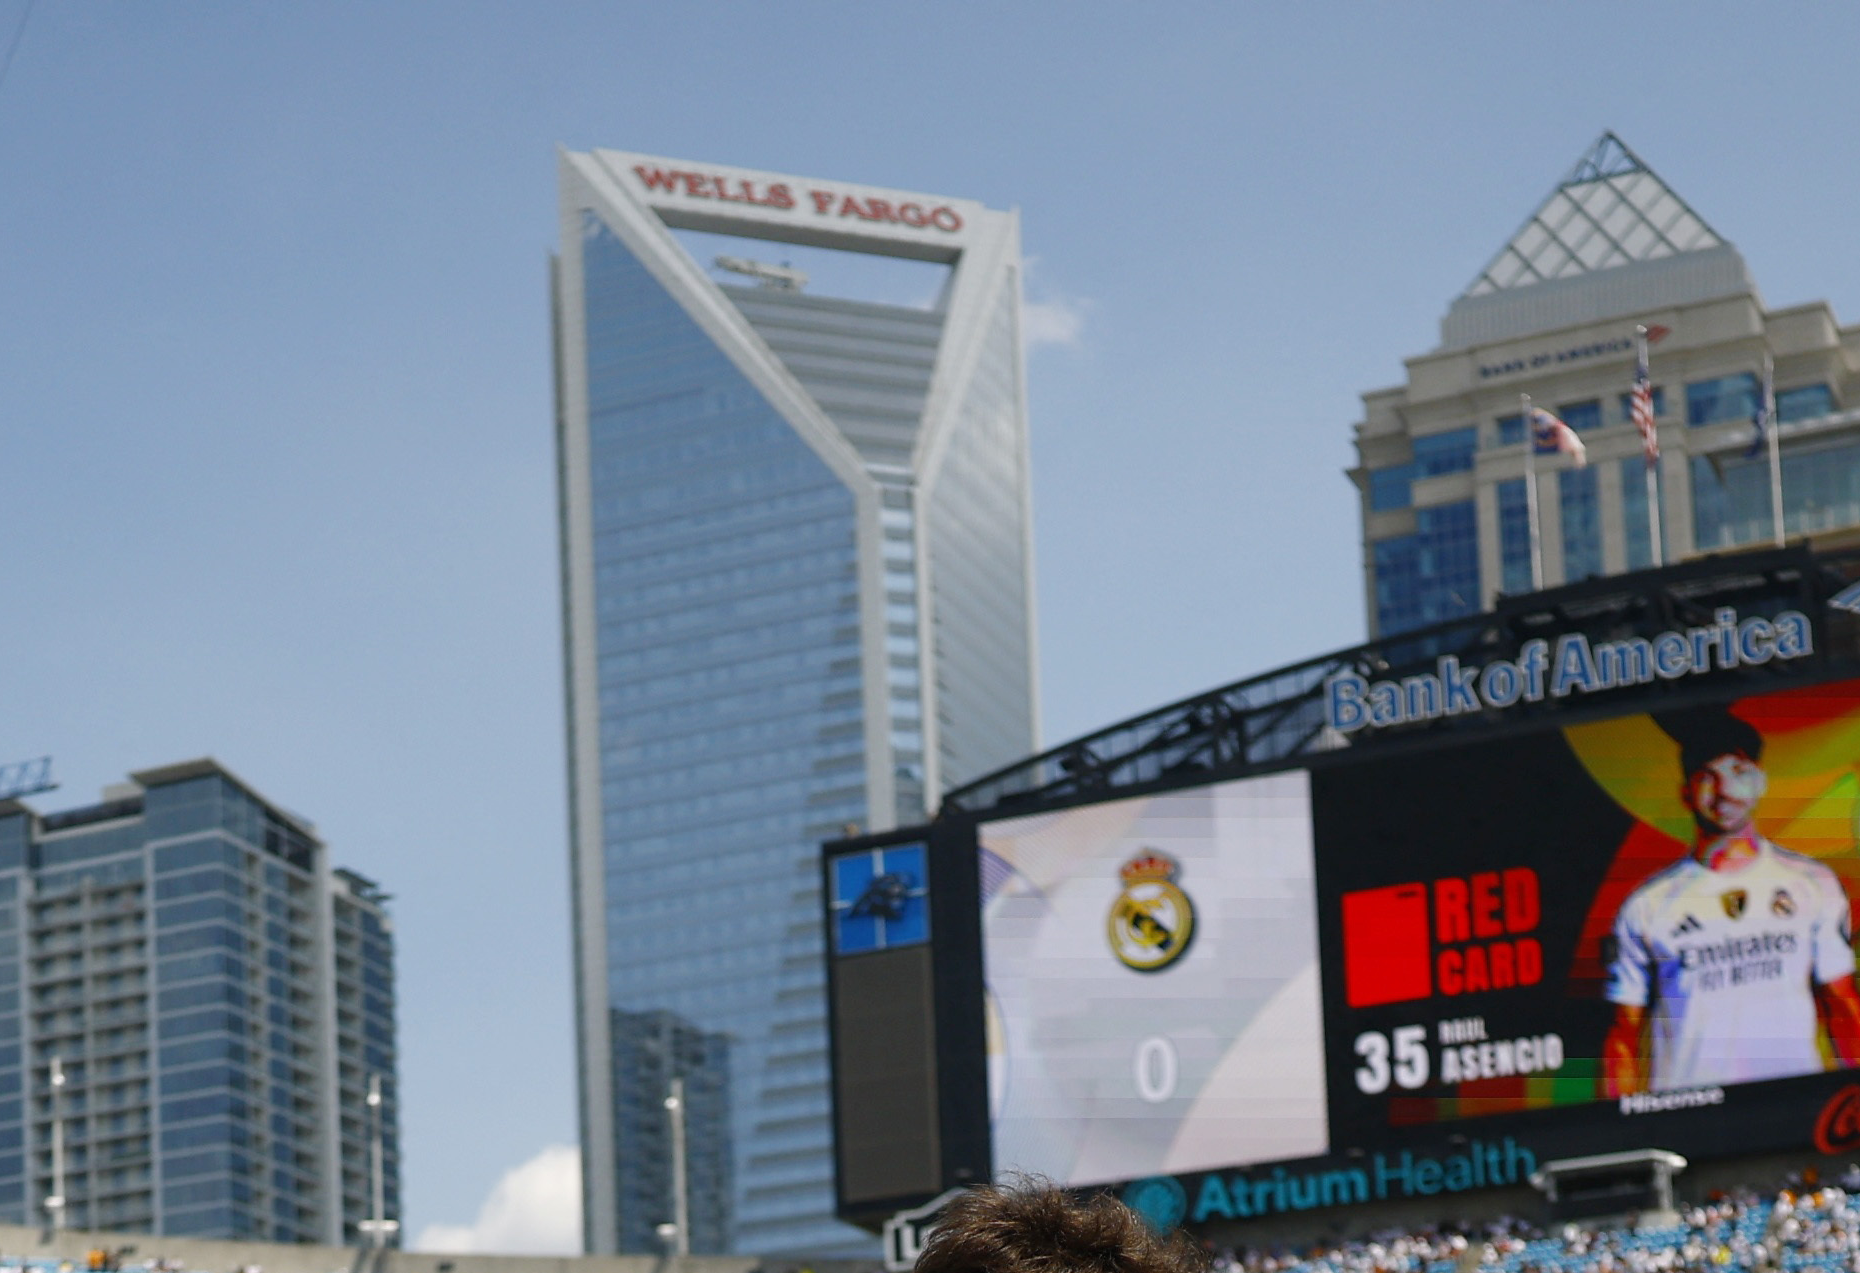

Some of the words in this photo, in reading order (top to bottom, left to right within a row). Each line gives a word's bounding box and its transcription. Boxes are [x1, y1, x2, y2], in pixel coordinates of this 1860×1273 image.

[634, 165, 796, 210] WELLS
[811, 189, 963, 232] FARGO
[1324, 655, 1482, 732] Bank
[1480, 639, 1549, 707] of
[1551, 606, 1814, 697] America
[1434, 866, 1541, 944] RED
[1437, 937, 1543, 996] CARD
[1135, 1037, 1178, 1103] 0
[1354, 1024, 1430, 1095] 35
[1441, 1032, 1564, 1084] ASENCIO
[1619, 1086, 1724, 1115] Hisense
[1191, 1166, 1368, 1222] Atrium
[1374, 1136, 1537, 1199] Health
